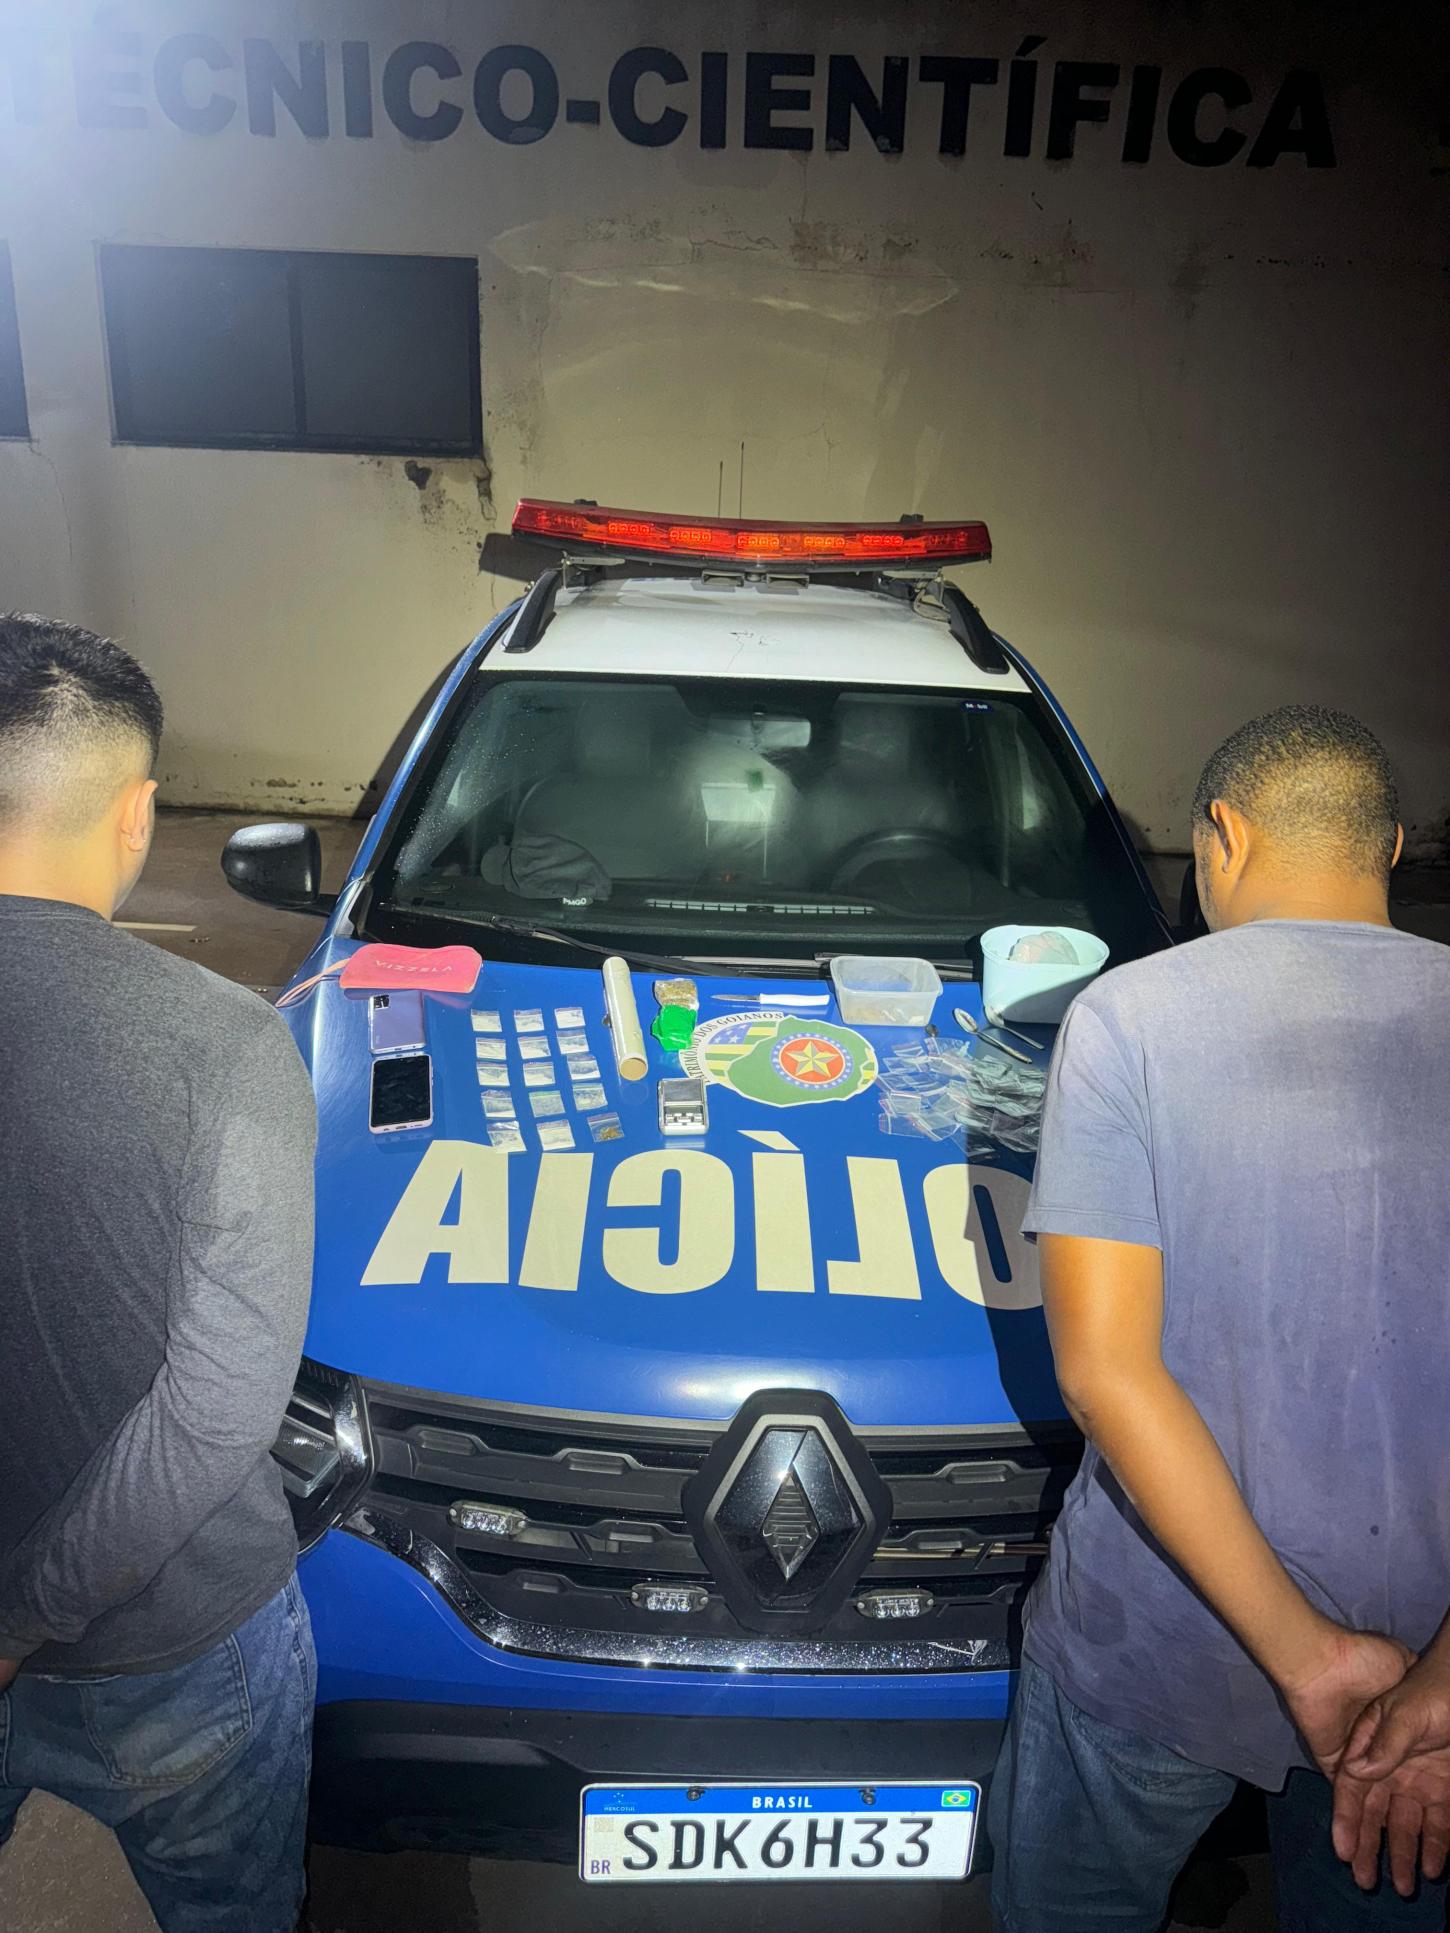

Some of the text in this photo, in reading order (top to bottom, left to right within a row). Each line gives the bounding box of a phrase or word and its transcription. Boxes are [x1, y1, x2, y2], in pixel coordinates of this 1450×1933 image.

[695, 1023, 718, 1038] DOS
[717, 1012, 783, 1025] GOIANOS
[752, 1796, 813, 1809] BRASIL
[623, 1818, 933, 1871] SDK6H33
[591, 1860, 611, 1875] BR
